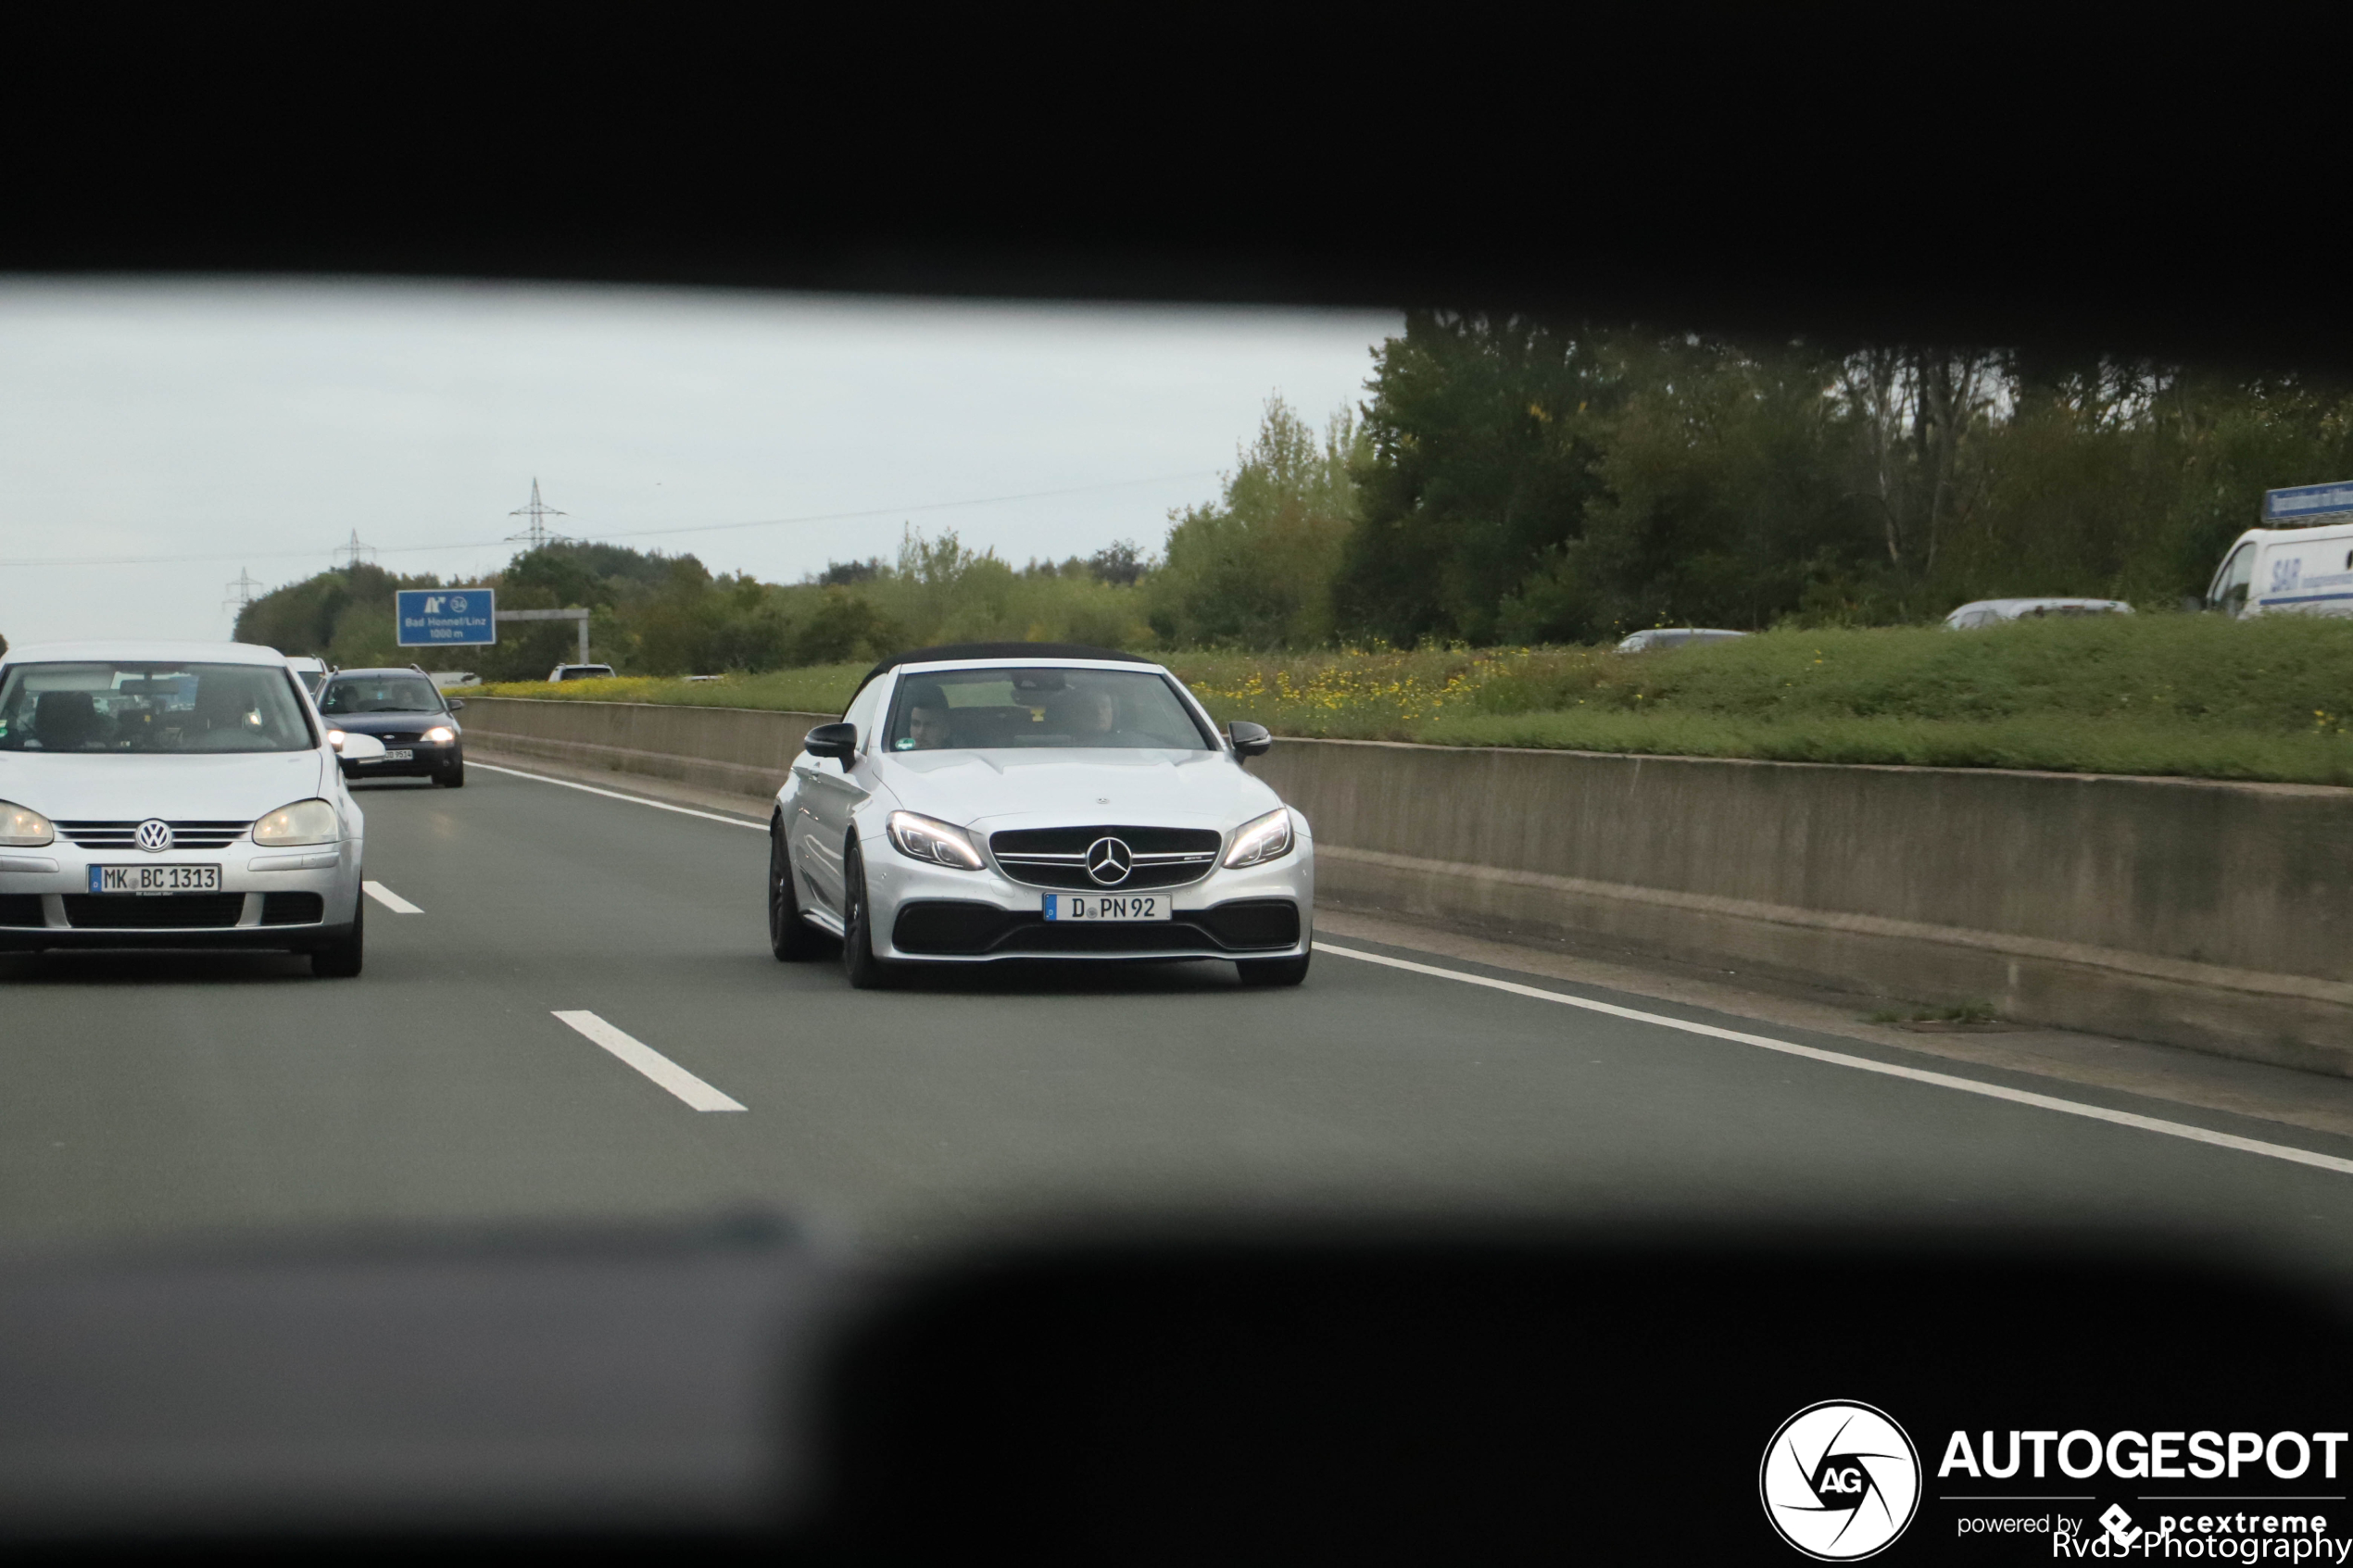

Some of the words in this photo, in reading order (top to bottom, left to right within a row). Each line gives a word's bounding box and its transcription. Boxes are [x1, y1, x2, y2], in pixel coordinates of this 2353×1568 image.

[452, 599, 467, 610] 34
[405, 618, 424, 627] Bad
[431, 629, 452, 638] 1000
[138, 821, 170, 849] VW
[104, 869, 128, 889] MK
[141, 869, 164, 888] BC
[170, 869, 215, 888] 1313
[1072, 898, 1085, 918] D
[1101, 898, 1126, 918] PN
[1131, 898, 1155, 917] 92
